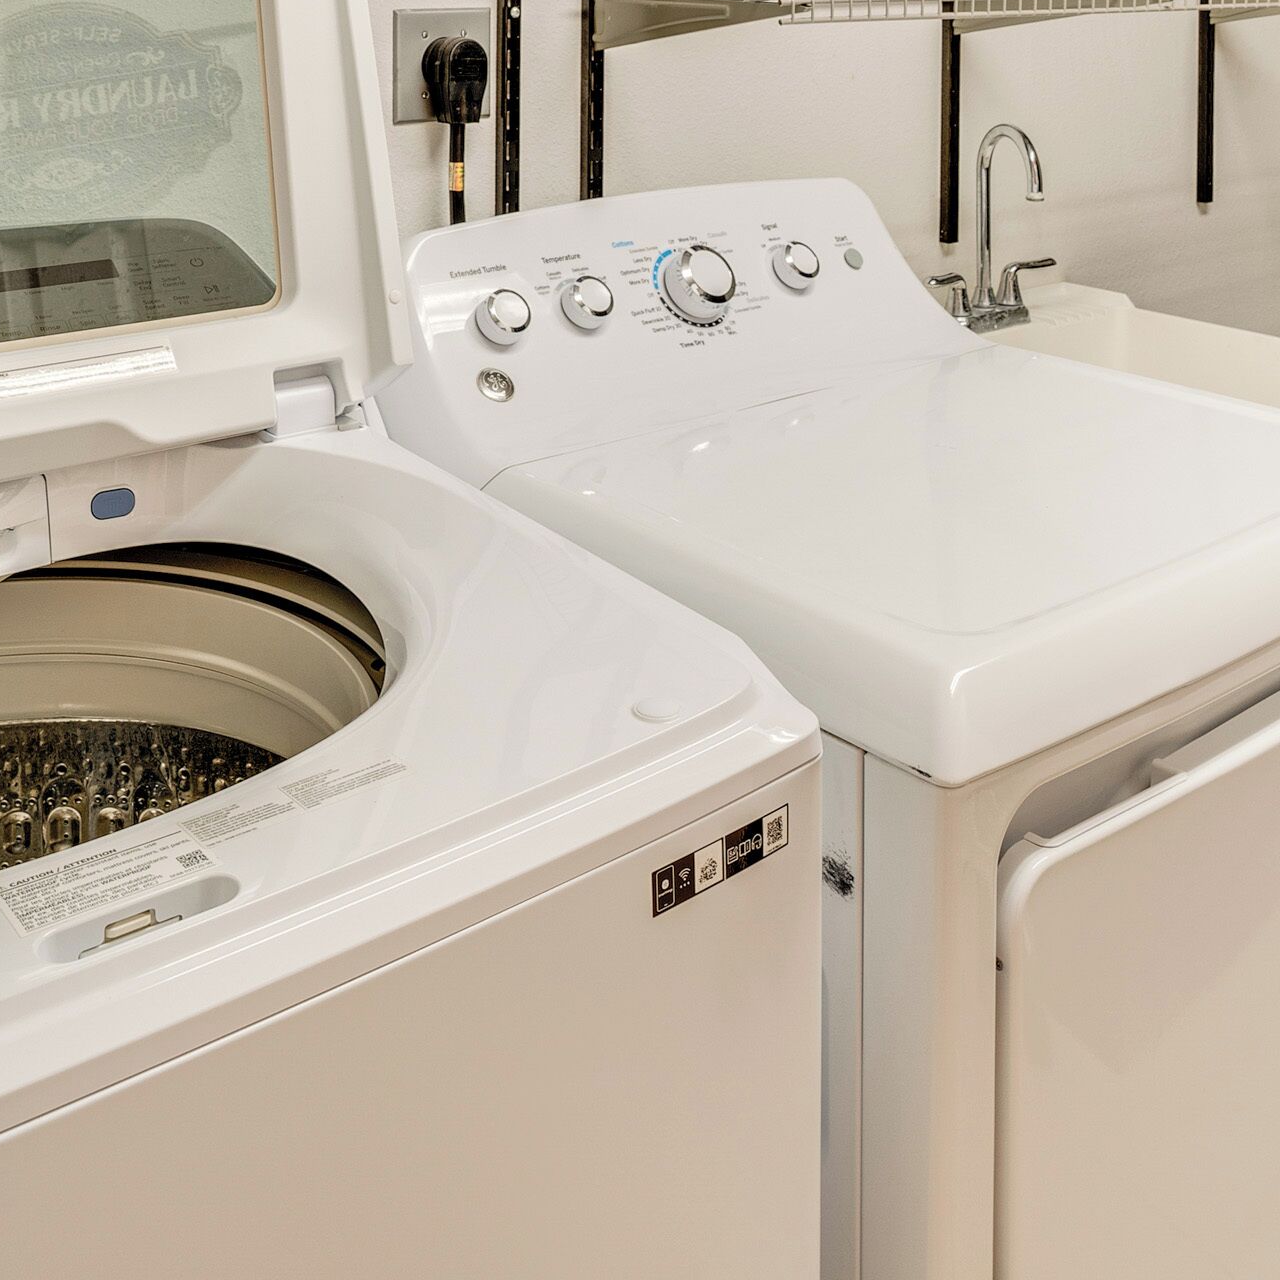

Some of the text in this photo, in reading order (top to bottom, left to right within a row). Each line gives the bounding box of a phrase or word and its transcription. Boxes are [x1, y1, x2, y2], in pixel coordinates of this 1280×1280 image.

[761, 222, 778, 231] Signal
[611, 240, 634, 248] Cottons
[834, 235, 848, 243] Start
[541, 253, 581, 265] Temperature
[449, 264, 507, 279] Extended Tumble
[680, 339, 705, 349] Time Dry
[8, 847, 117, 888] CAUTION ATTENTION
